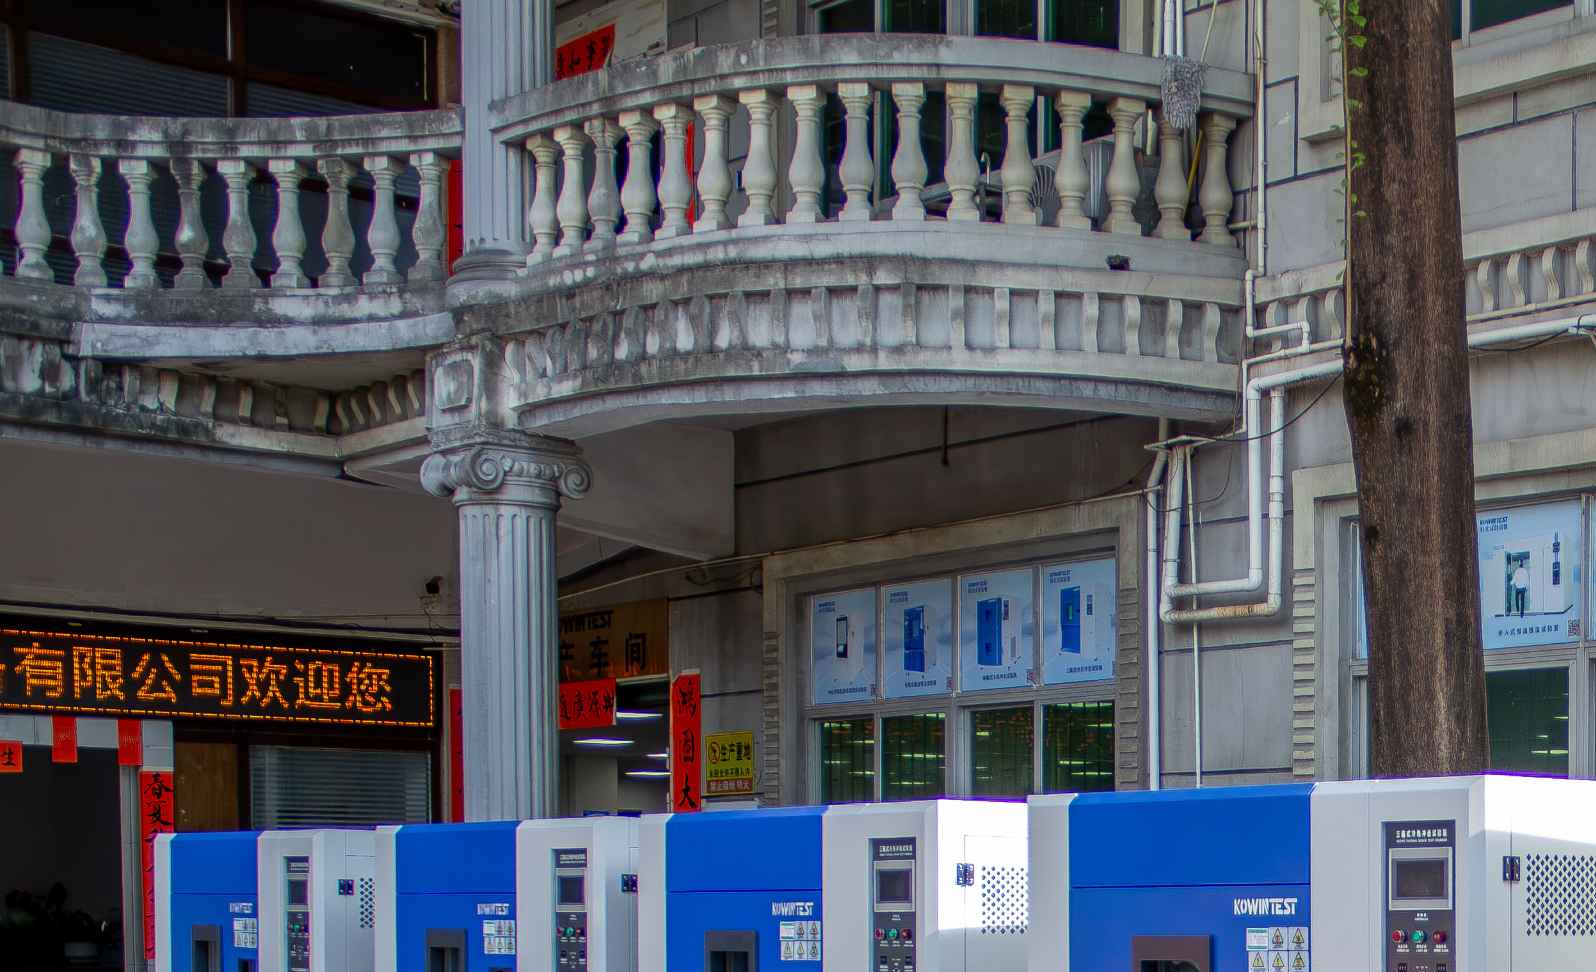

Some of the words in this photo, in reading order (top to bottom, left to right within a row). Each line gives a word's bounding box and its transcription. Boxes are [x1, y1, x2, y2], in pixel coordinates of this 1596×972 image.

[0, 641, 393, 712] 有限公司欢迎您
[1233, 898, 1298, 915] KOWINTEST
